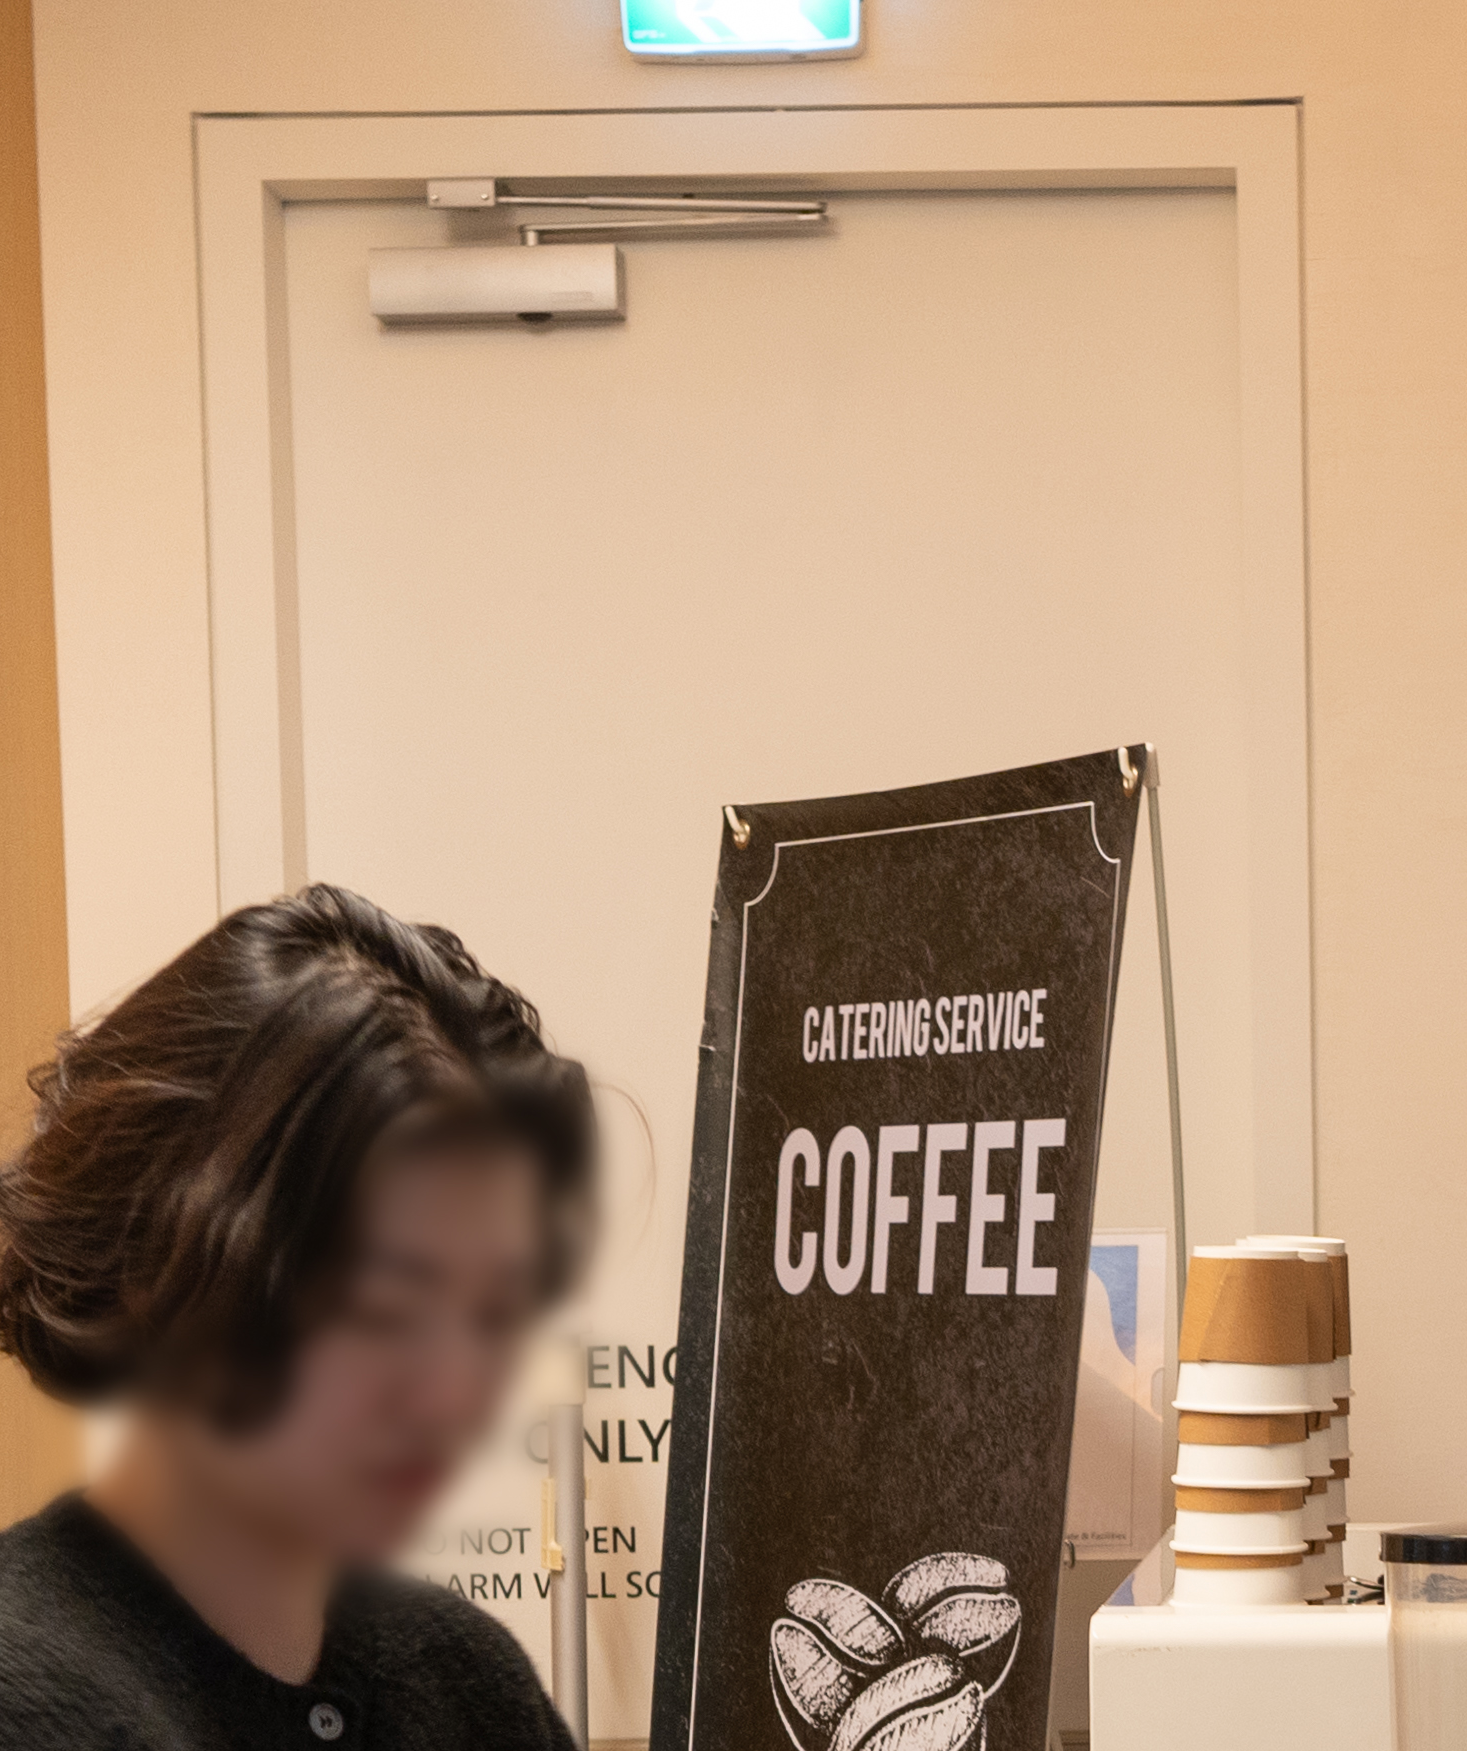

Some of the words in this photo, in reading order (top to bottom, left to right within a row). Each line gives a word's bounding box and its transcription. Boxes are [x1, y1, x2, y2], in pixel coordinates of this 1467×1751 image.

[803, 998, 931, 1064] CATERING
[933, 988, 1048, 1055] SERVICE
[774, 1118, 1067, 1296] COFFEE
[460, 1528, 531, 1555] NOT
